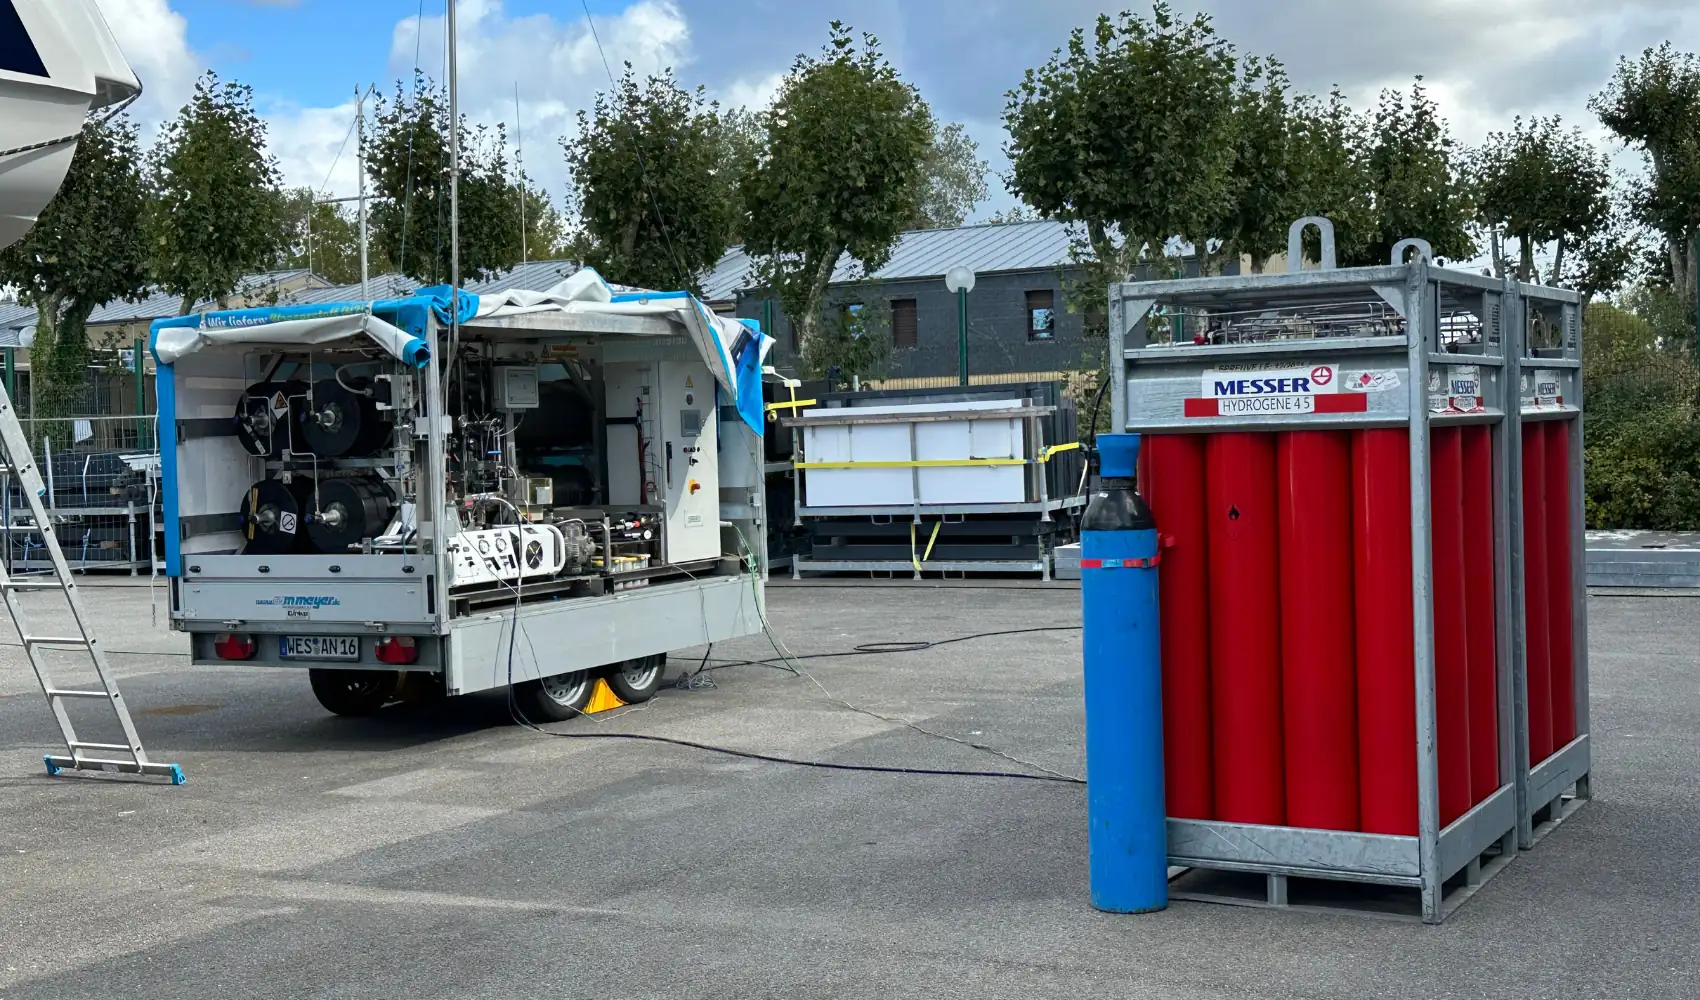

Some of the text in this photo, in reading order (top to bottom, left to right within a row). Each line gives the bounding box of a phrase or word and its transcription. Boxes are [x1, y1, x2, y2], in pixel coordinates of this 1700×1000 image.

[207, 317, 227, 327] Wir
[1215, 377, 1311, 396] MESSER
[1451, 380, 1475, 395] MESSER
[1223, 398, 1291, 412] HYDROGENE
[287, 637, 356, 655] WES AN 16
